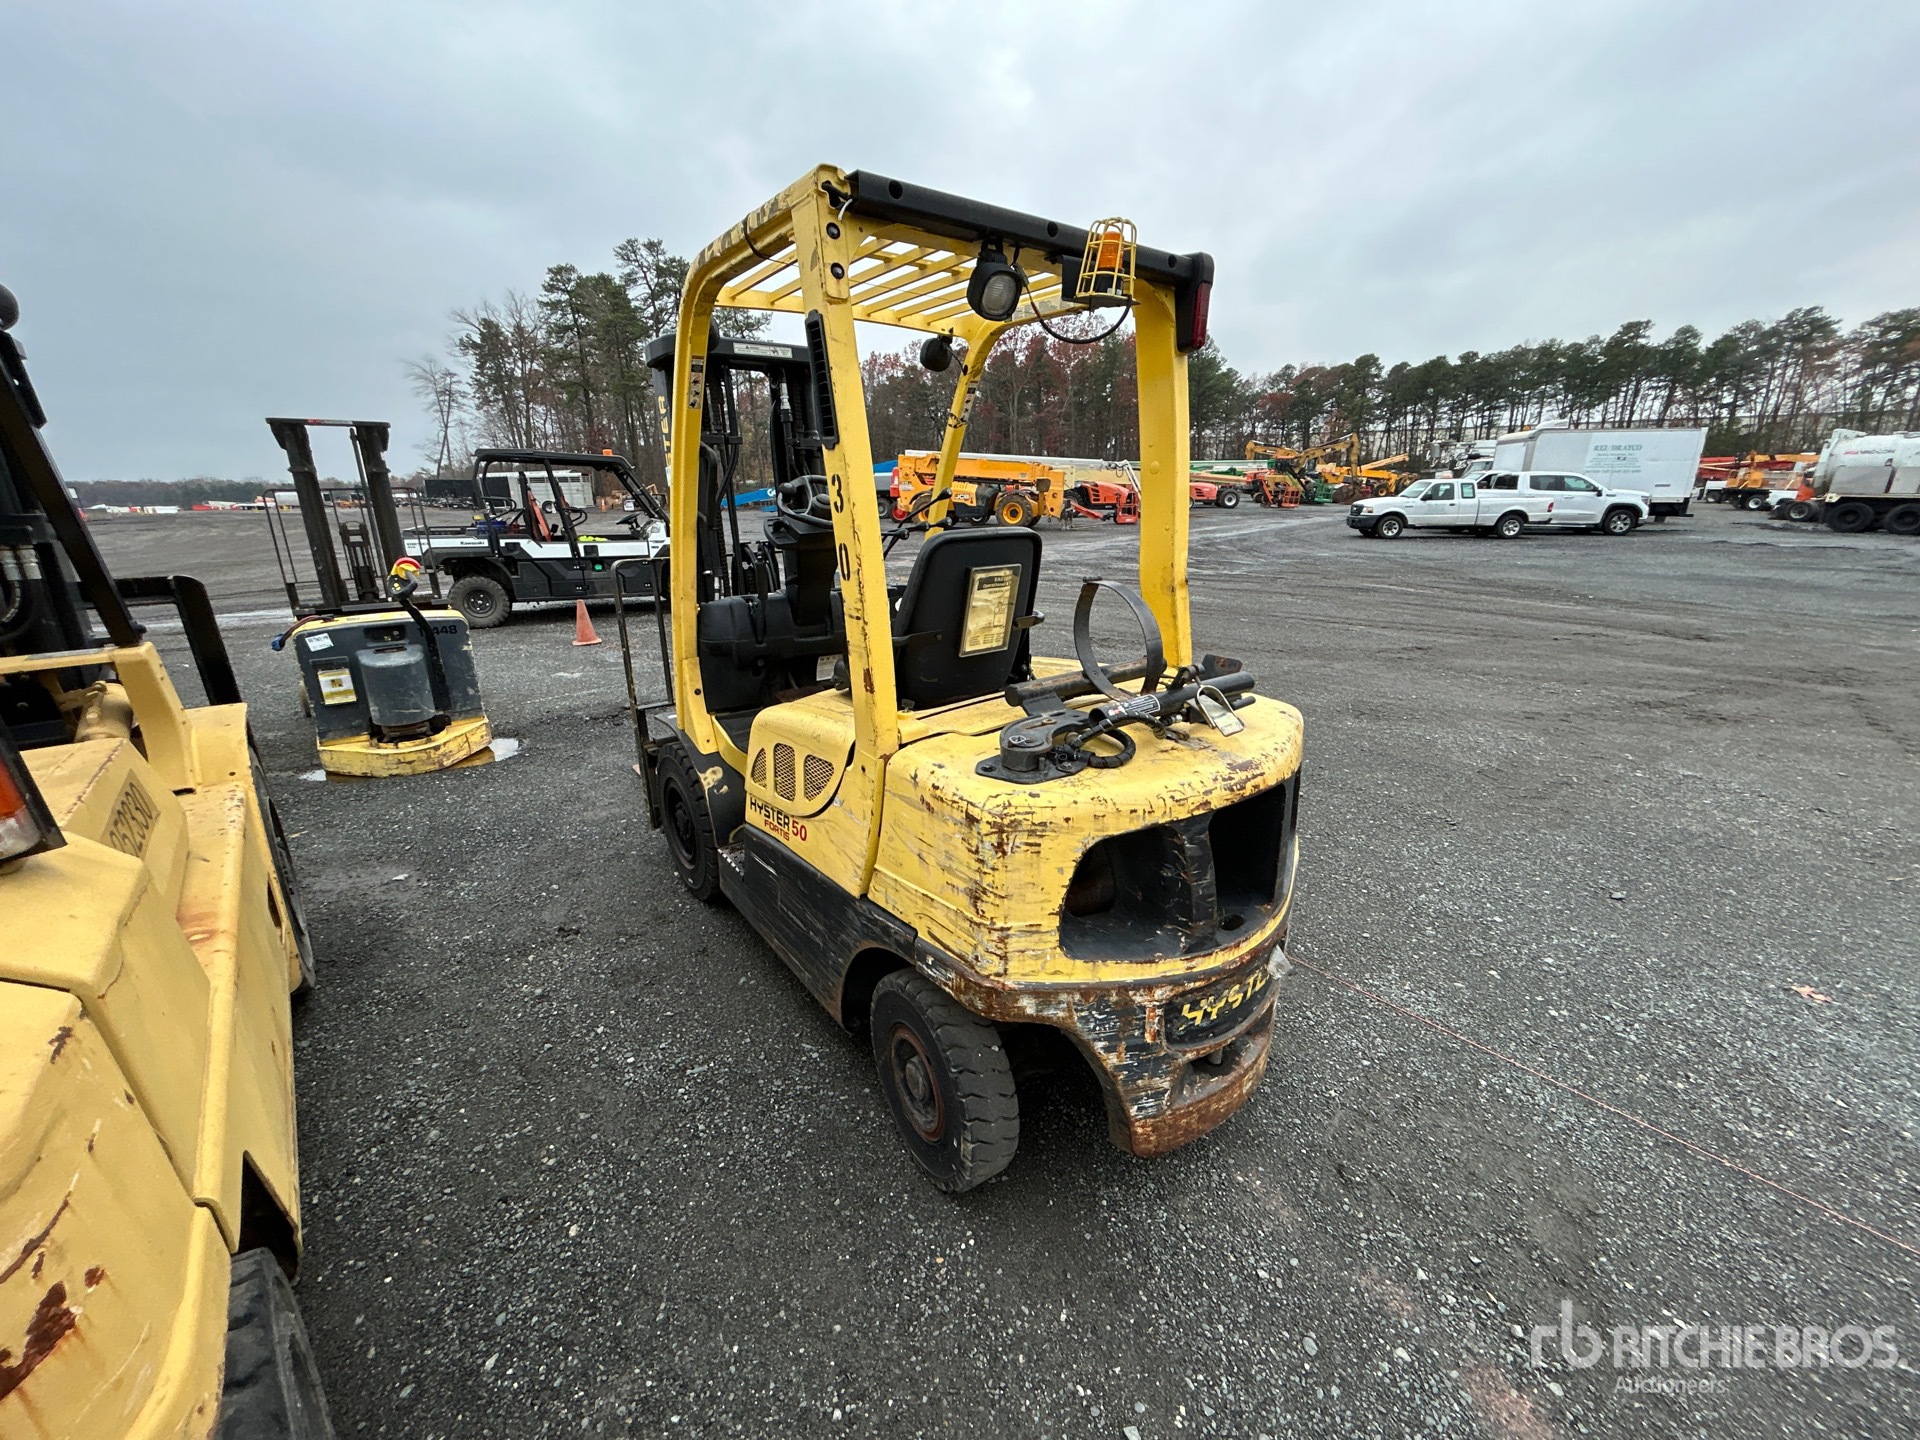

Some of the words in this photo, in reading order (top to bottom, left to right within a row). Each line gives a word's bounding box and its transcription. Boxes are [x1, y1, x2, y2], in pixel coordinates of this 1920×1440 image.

[750, 797, 790, 832] HYSTER
[792, 819, 807, 841] 50
[764, 819, 790, 841] FORTIS
